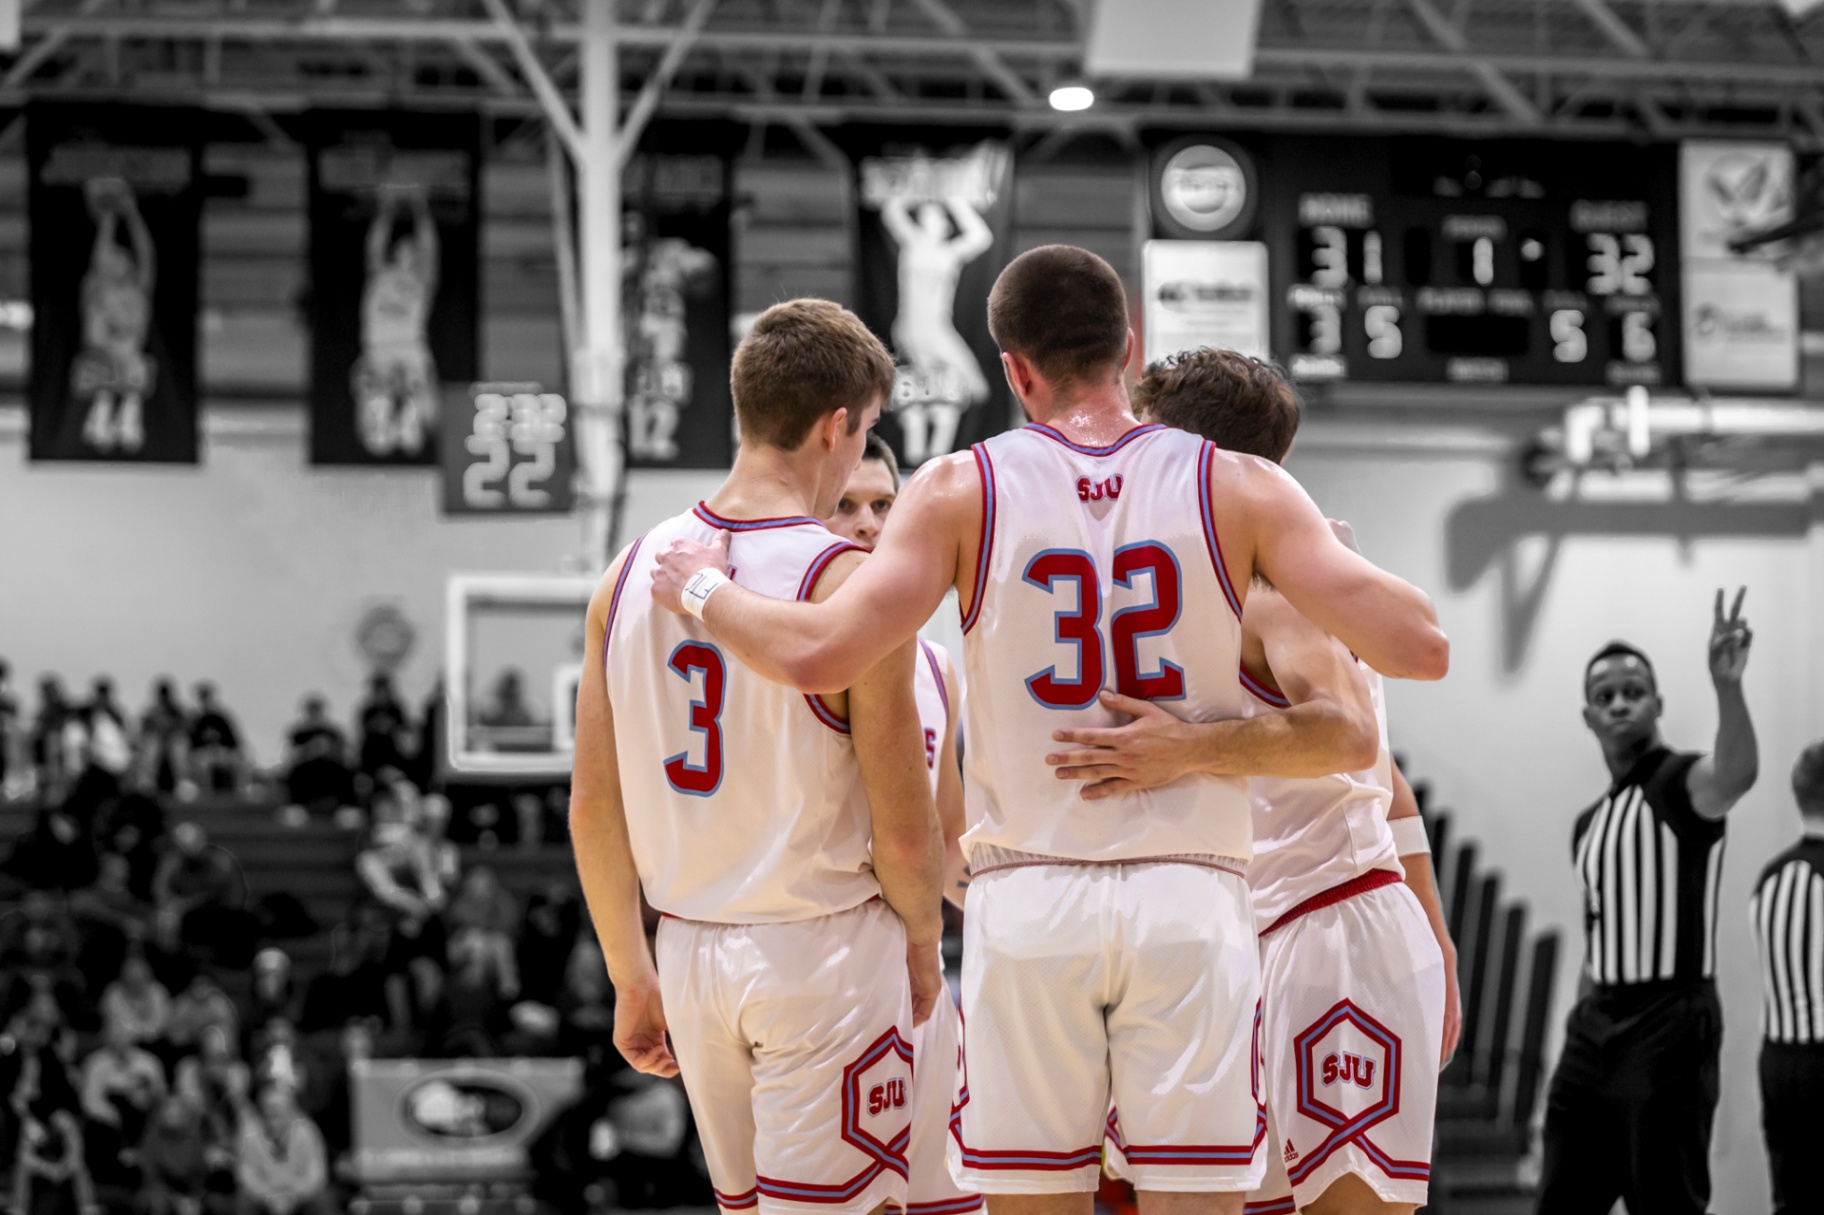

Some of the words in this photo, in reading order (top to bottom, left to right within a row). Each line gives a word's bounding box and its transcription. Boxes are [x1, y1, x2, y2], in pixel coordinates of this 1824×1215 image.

[1312, 227, 1382, 289] 31
[1587, 232, 1655, 295] 32
[1365, 306, 1402, 358] 5
[1550, 310, 1587, 362] 5
[1622, 312, 1656, 362] 6
[463, 435, 557, 509] 22
[1075, 473, 1124, 503] SJU
[1021, 539, 1186, 710] 32
[663, 639, 727, 797] 3
[1321, 1050, 1376, 1090] SJU
[867, 1077, 907, 1117] SJU
